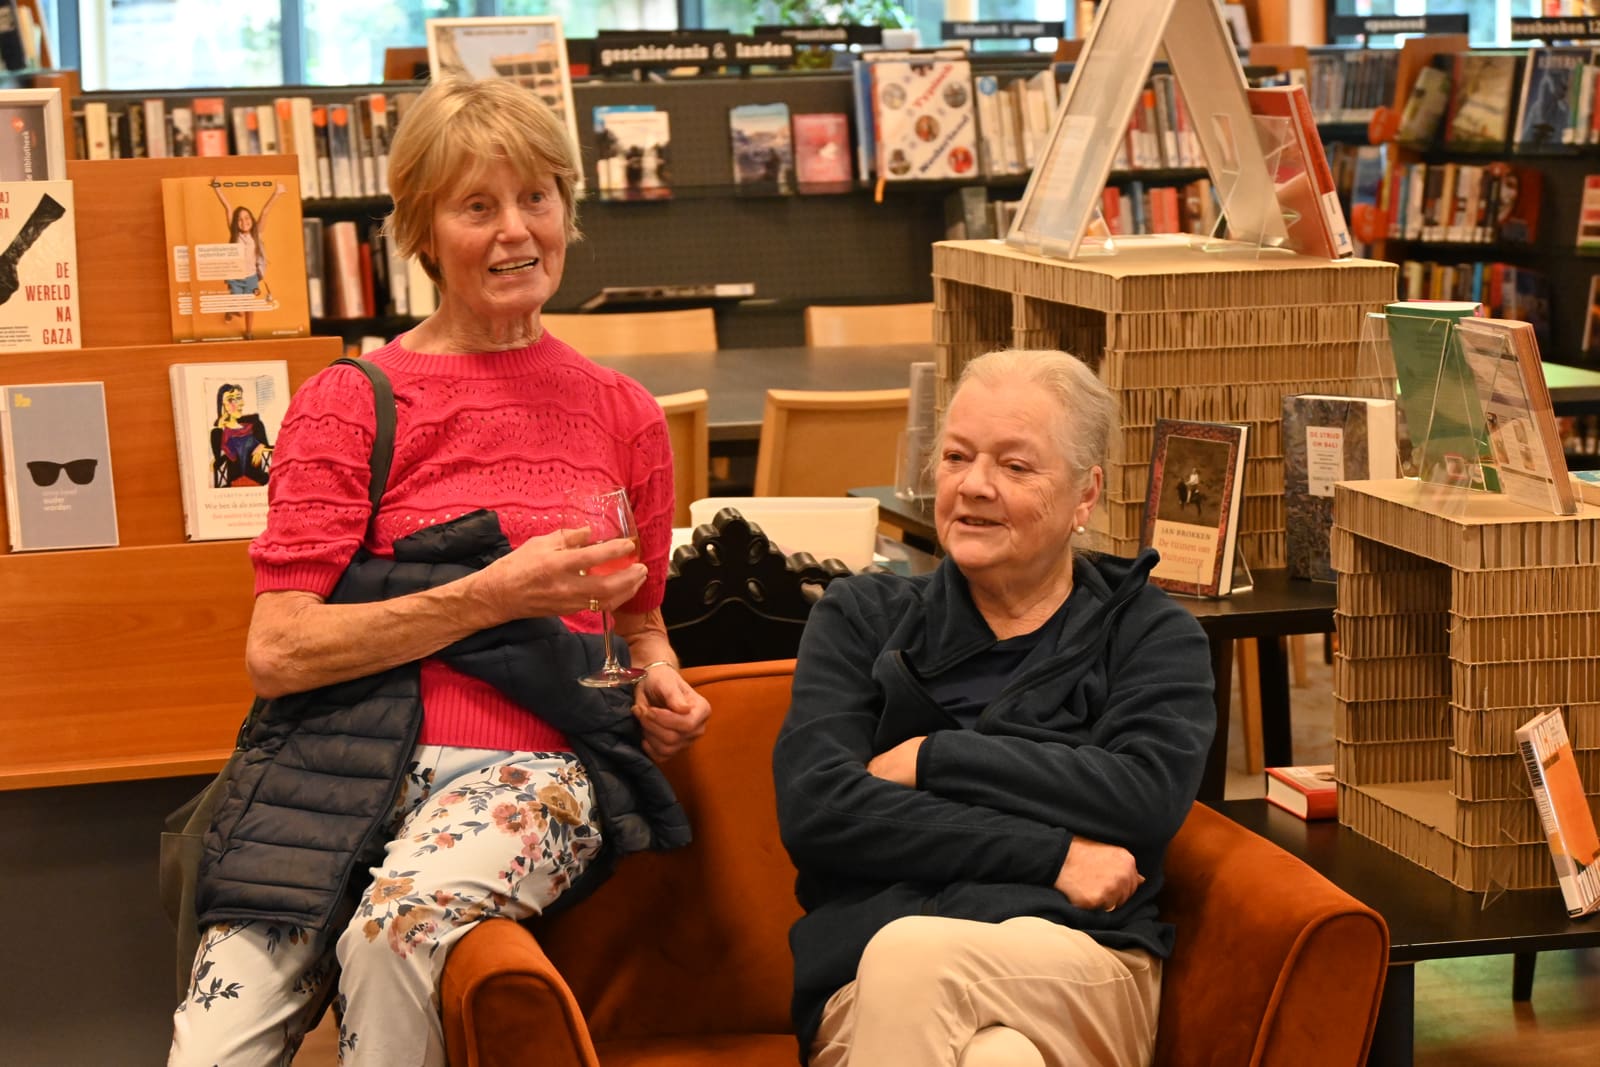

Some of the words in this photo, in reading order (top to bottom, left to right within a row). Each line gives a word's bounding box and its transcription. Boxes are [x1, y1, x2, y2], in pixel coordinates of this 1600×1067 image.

[1514, 20, 1586, 34] eesboeken
[601, 43, 709, 66] geschiedenis
[713, 43, 726, 59] &
[736, 41, 792, 58] landen
[56, 262, 70, 279] DE
[25, 284, 71, 302] WERELD
[56, 306, 73, 323] NA
[42, 327, 73, 345] GAZA
[1319, 432, 1340, 440] STRIJD
[1161, 527, 1175, 535] JAN
[1177, 529, 1212, 540] BROKKEN
[1158, 537, 1169, 548] De
[1526, 760, 1544, 788] KRAMER
